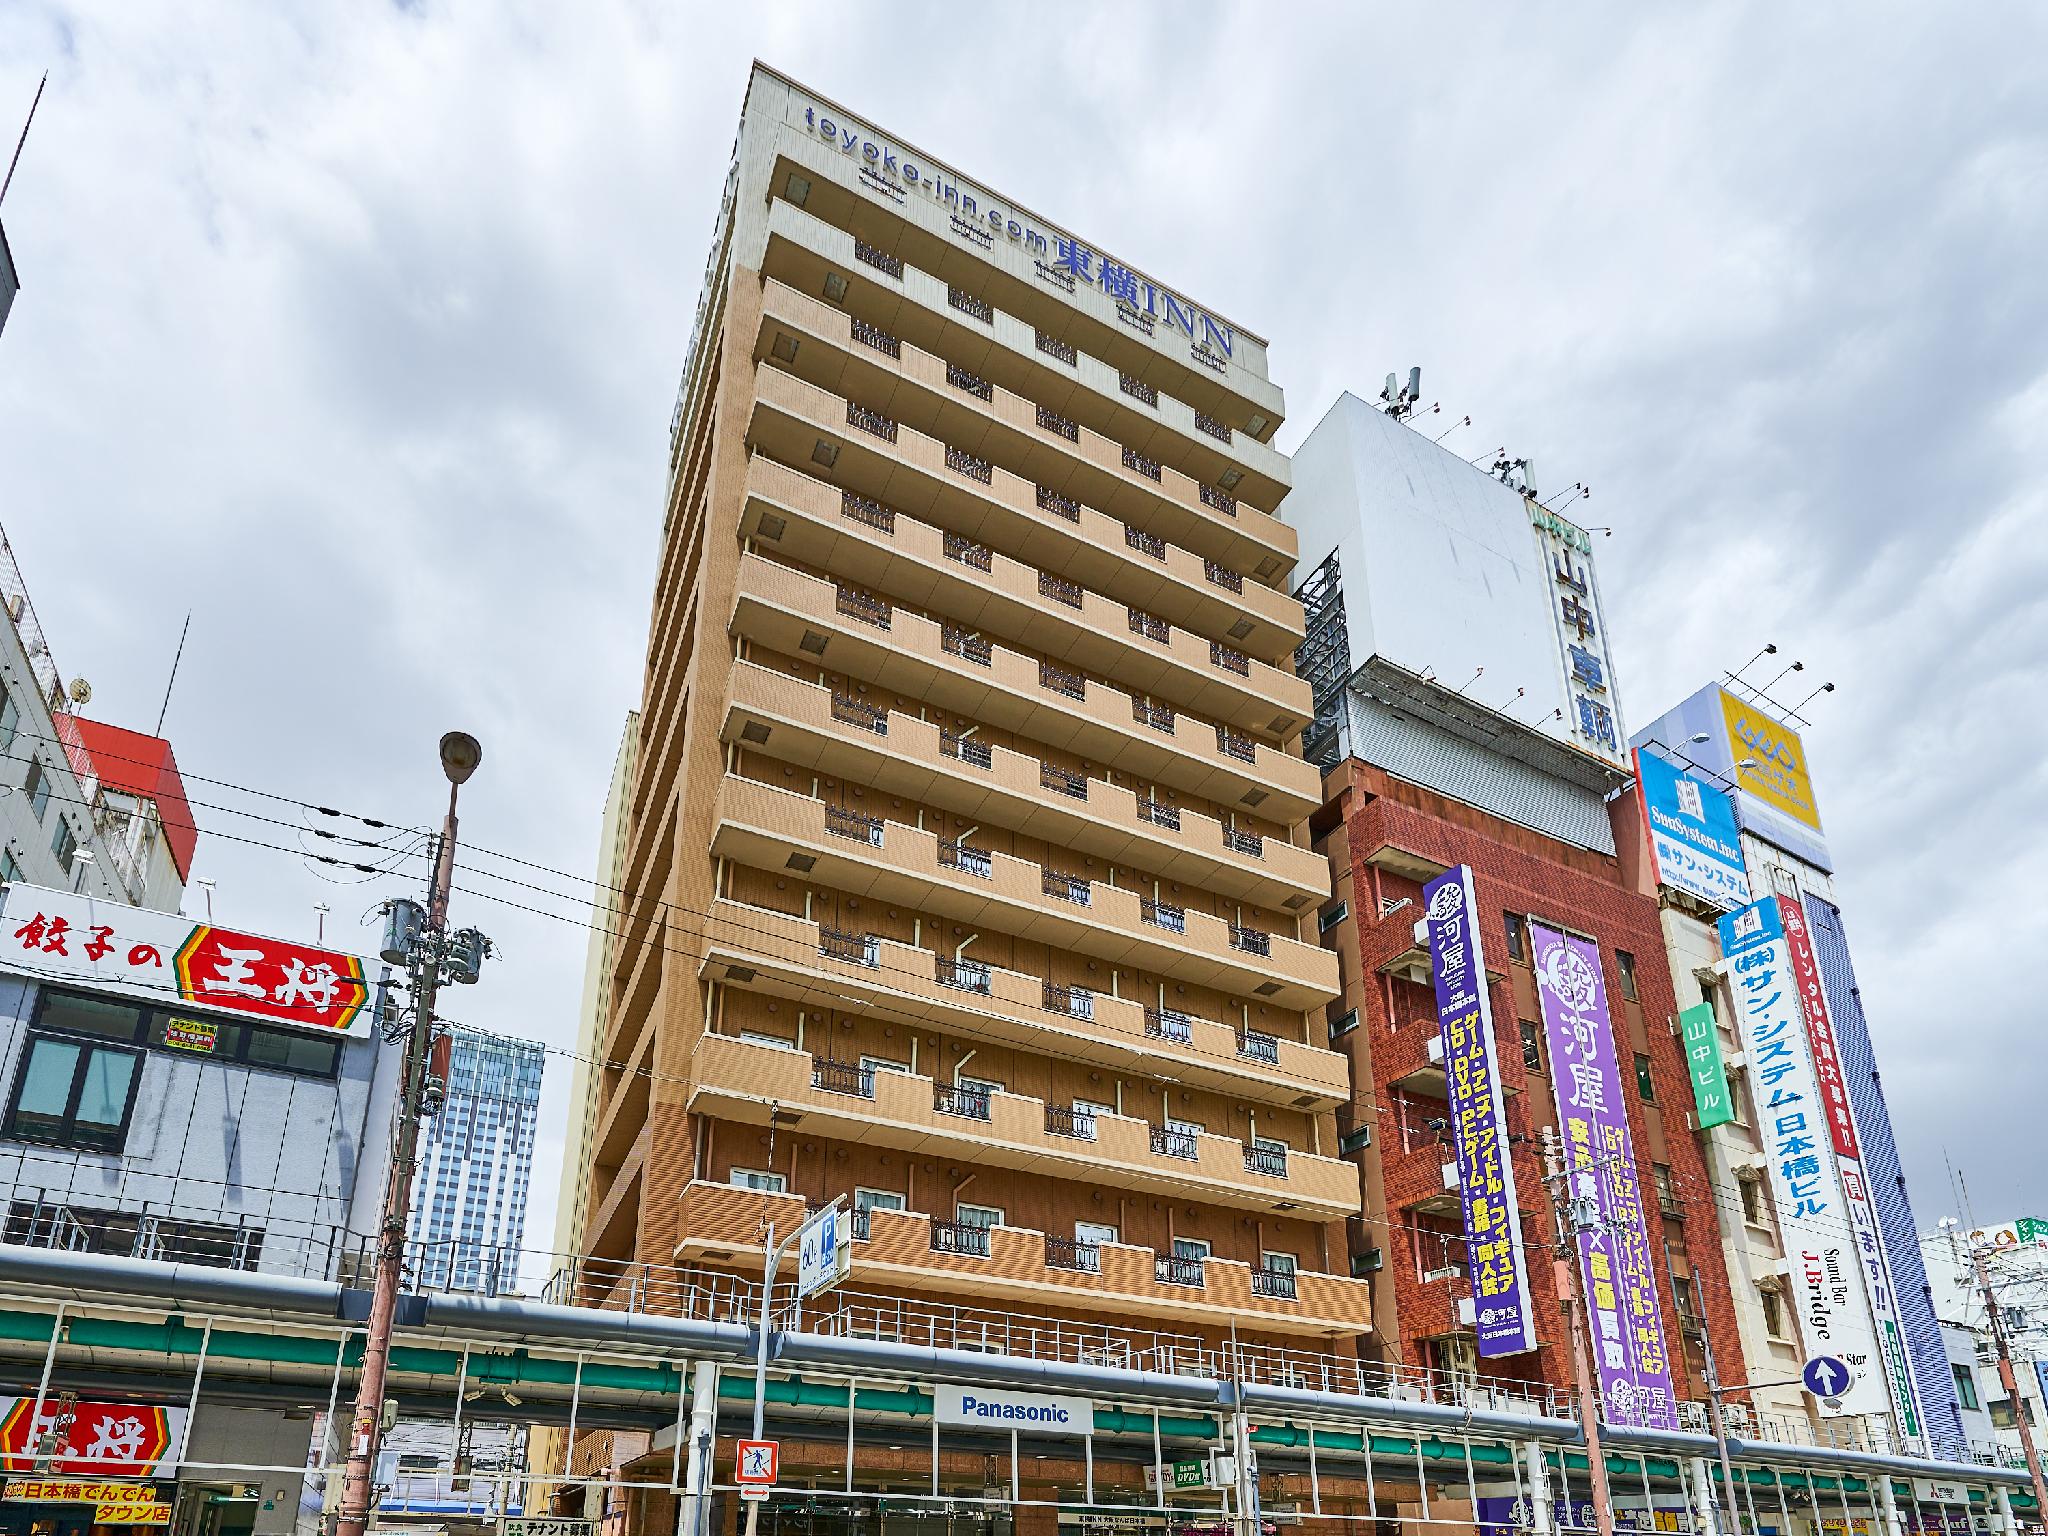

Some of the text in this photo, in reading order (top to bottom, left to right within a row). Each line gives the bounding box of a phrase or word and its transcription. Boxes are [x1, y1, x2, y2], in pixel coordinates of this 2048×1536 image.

[805, 106, 1233, 358] toyoko-inn.com 東横INN
[14, 912, 340, 1014] 餃子の 王将
[1687, 1021, 1720, 1111] 山中ビル
[1801, 1250, 1832, 1340] J.Bridge
[1823, 1248, 1848, 1307] Sound Bar
[961, 1395, 1069, 1425] Panasonic
[24, 1481, 155, 1503] 日本橋でんでん
[97, 1505, 171, 1521] タウン店
